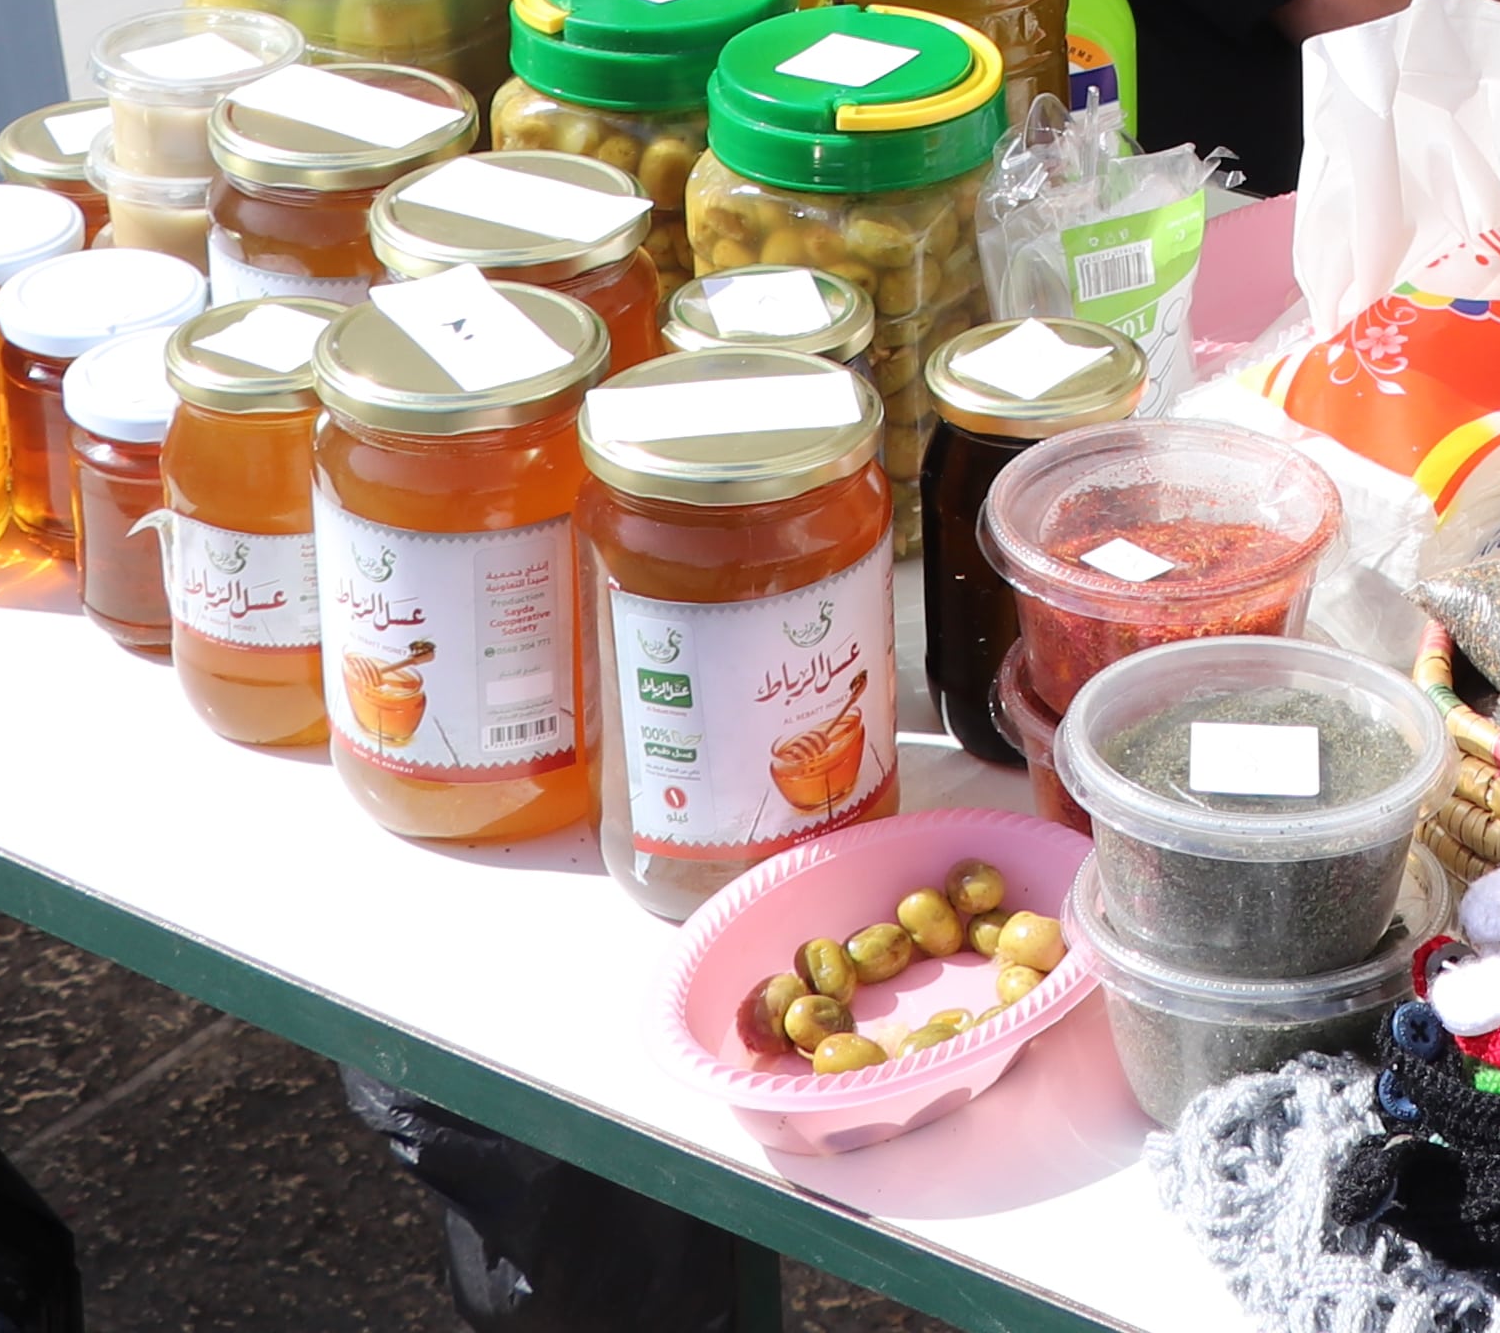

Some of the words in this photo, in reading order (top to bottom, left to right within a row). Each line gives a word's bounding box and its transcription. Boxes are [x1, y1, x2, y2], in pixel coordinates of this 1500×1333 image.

[1069, 46, 1093, 62] RMS
[229, 578, 289, 620] عسل
[491, 591, 546, 608] Production
[373, 596, 427, 632] عسل
[489, 610, 552, 629] Cooperative
[503, 604, 536, 617] Sayda
[501, 623, 538, 637] Society
[814, 632, 861, 695] عسل
[753, 650, 827, 707] الرباط
[783, 717, 796, 726] AL
[825, 693, 850, 711] HONEY
[640, 725, 672, 744] 100%
[665, 811, 690, 824] كيلو
